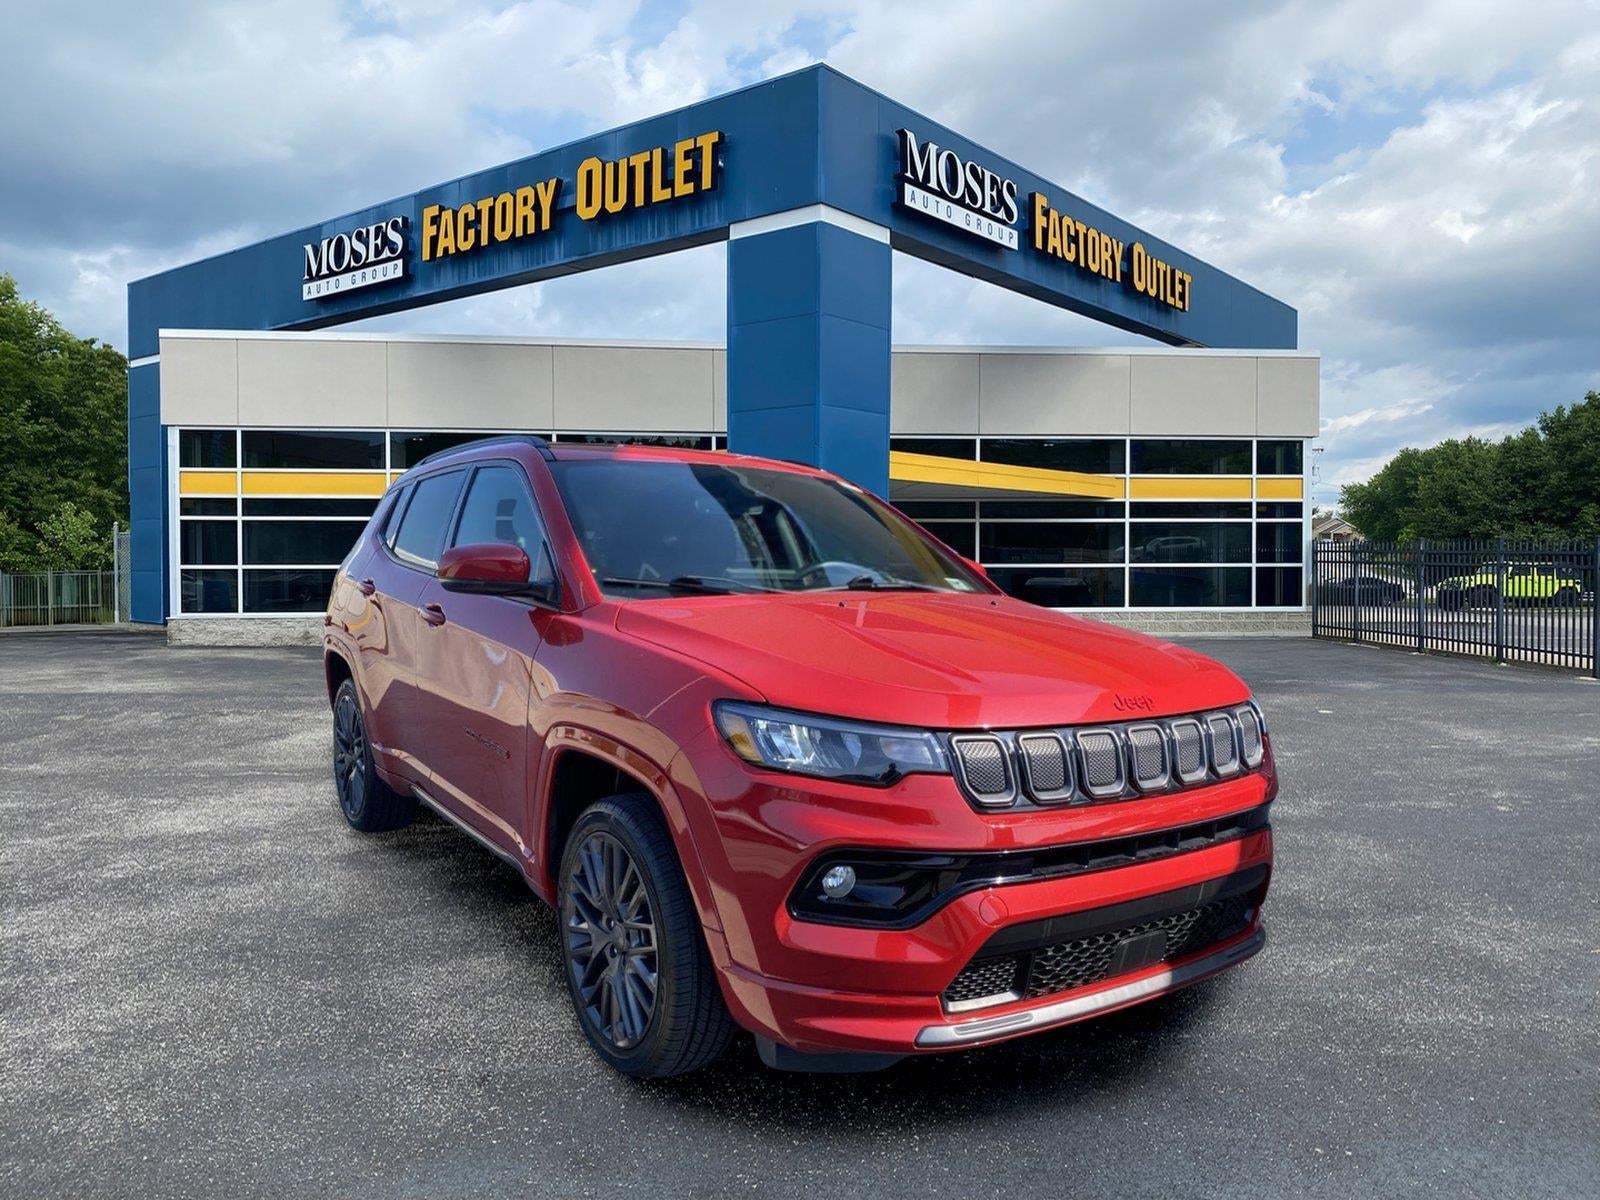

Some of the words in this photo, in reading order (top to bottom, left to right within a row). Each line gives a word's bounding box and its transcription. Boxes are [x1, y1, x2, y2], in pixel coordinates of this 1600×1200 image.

[421, 178, 558, 261] FACTORY
[575, 130, 720, 221] OUTLET
[905, 128, 1019, 225] MOSES
[303, 217, 403, 280] MOSES
[909, 190, 953, 218] AUTO
[964, 210, 1015, 244] GROUP
[306, 278, 340, 296] AUTO
[350, 263, 399, 286] GROUP
[1032, 191, 1124, 283] FACTORY
[1132, 242, 1192, 312] OUTLET
[1113, 694, 1154, 712] Jeep
